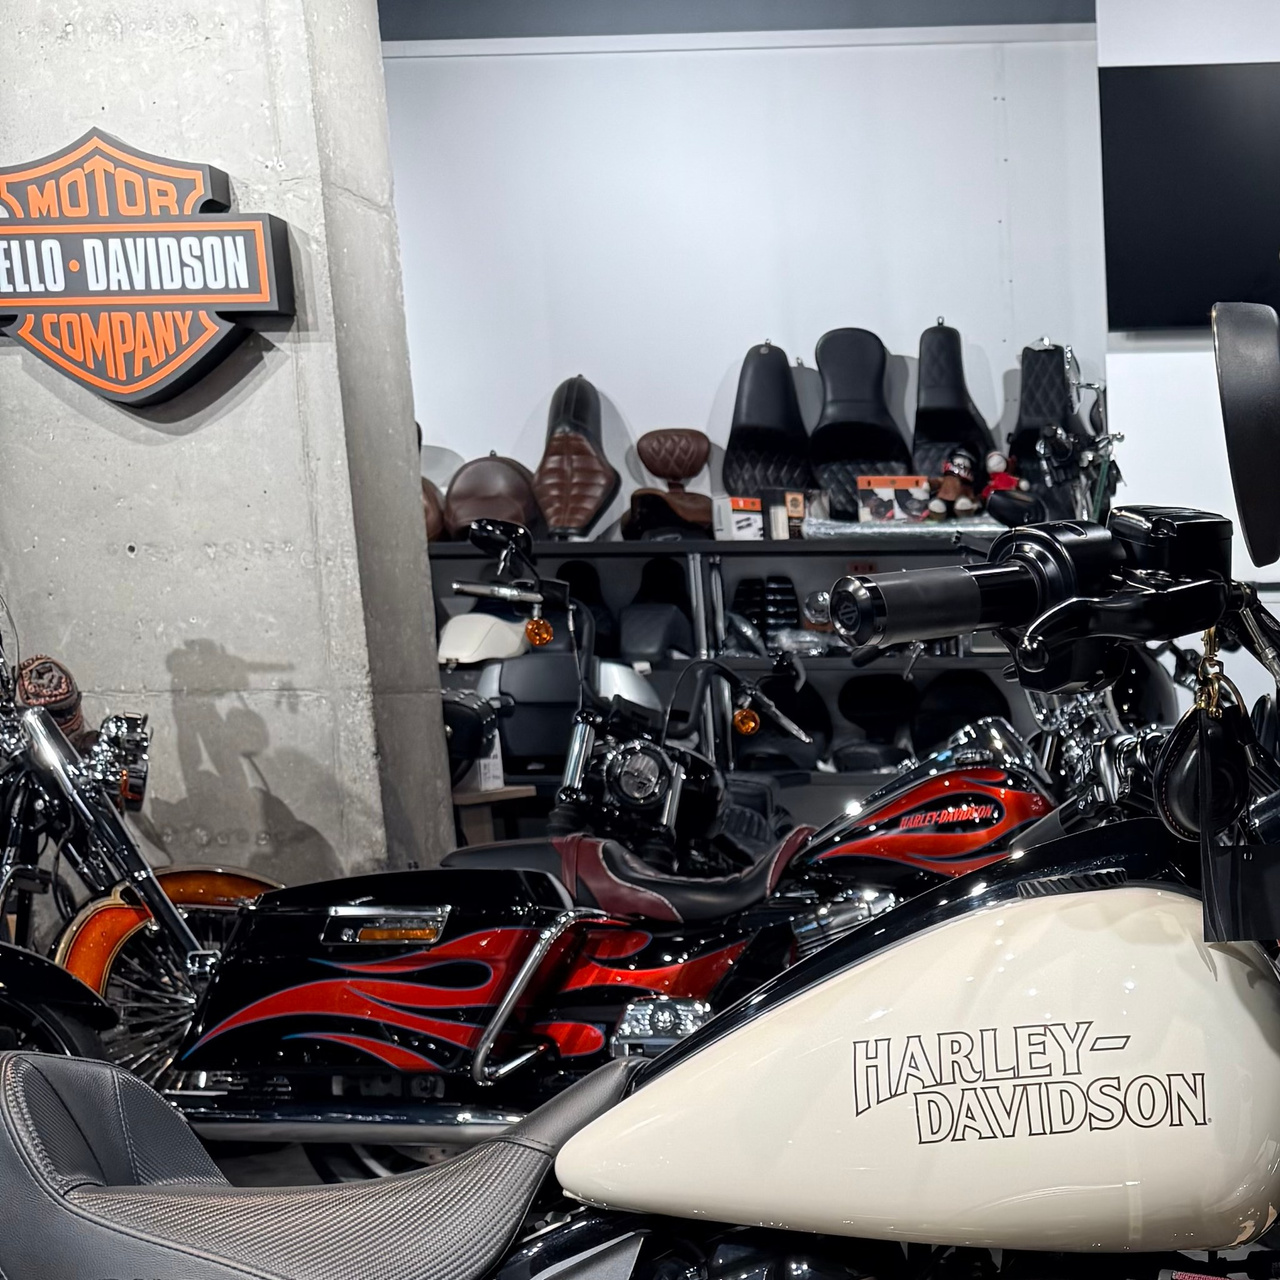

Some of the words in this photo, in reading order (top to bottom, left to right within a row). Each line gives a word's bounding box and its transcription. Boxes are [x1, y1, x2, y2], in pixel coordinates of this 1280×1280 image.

[27, 155, 179, 218] MOTOR
[0, 238, 66, 293] ELLO
[83, 236, 250, 291] DAVIDSON
[41, 311, 193, 381] COMPANY
[899, 804, 995, 829] HARLEY-DAVIDSON
[852, 1020, 1132, 1118] HARLEY-
[913, 1072, 1208, 1145] DAVIDSON
